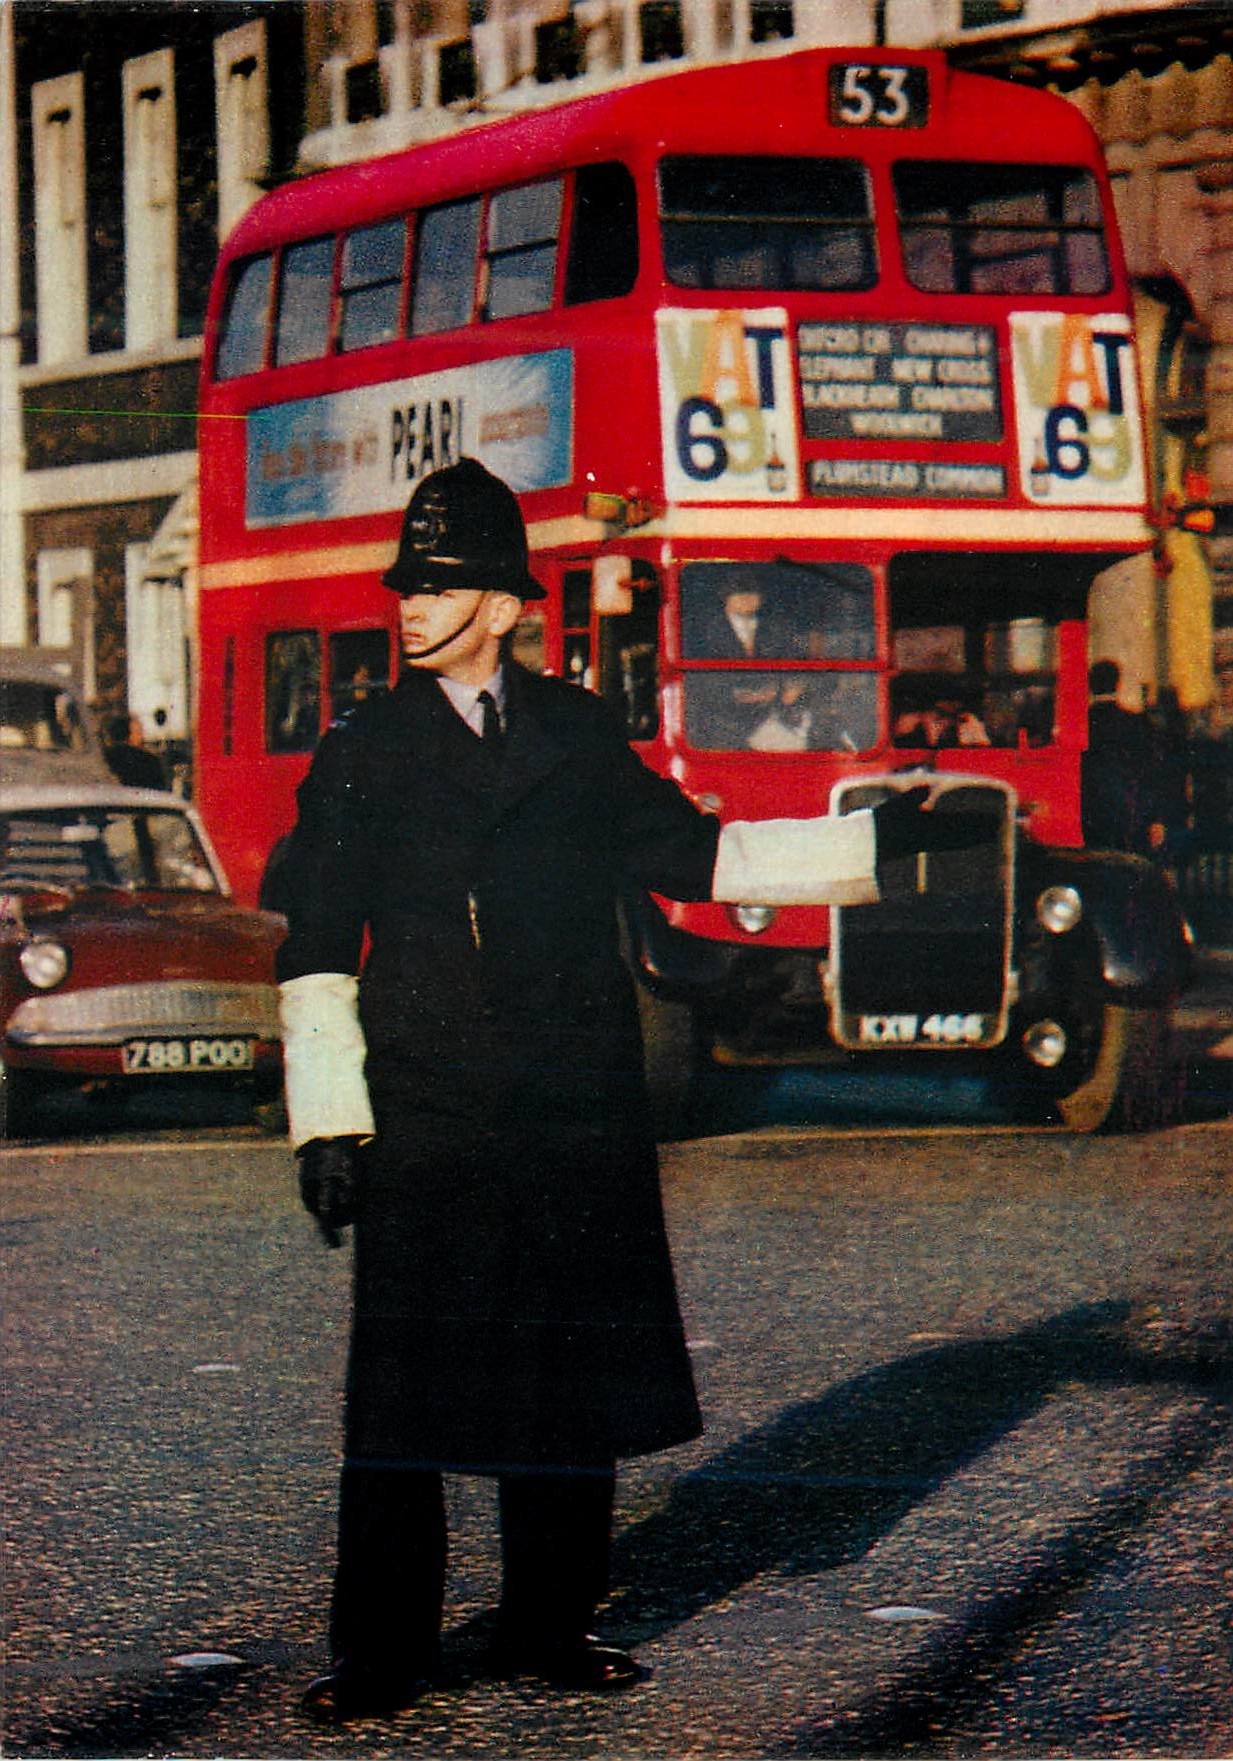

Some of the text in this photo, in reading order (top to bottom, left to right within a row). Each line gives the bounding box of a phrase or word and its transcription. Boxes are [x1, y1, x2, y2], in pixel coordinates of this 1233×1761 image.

[841, 66, 909, 126] 53
[658, 310, 784, 410] VAT
[1013, 313, 1132, 416] VAT
[676, 397, 766, 482] 69
[1044, 406, 1132, 482] 69
